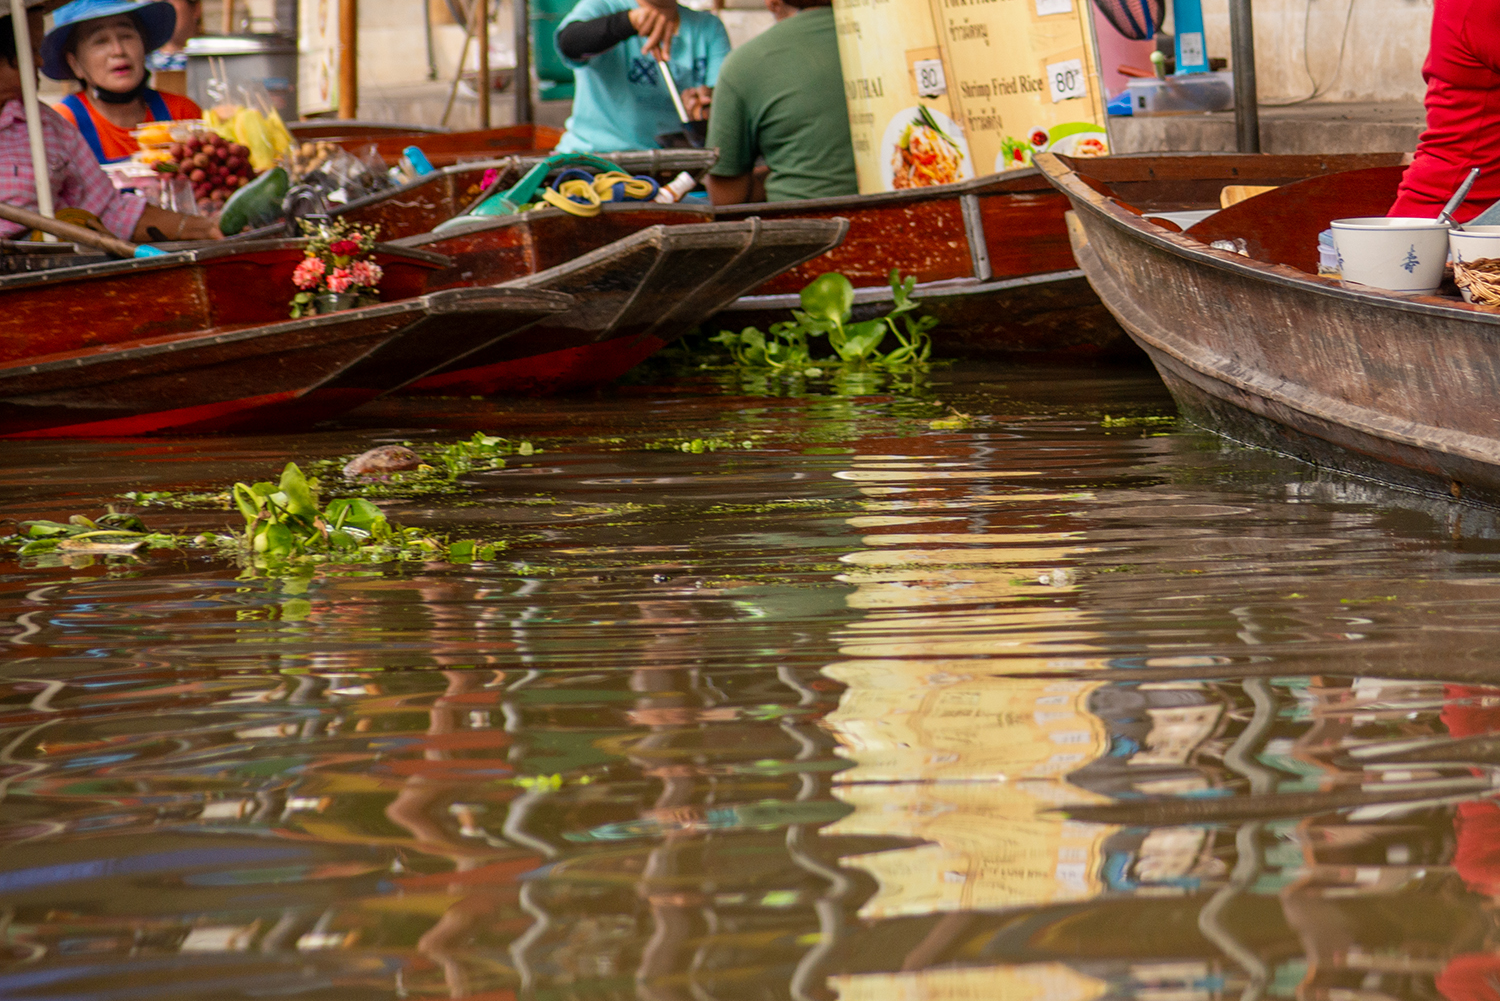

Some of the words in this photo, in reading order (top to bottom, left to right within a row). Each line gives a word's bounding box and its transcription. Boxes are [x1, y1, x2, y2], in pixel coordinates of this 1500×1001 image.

[921, 68, 938, 89] 80
[961, 80, 991, 101] Shrimp
[991, 77, 1018, 96] Fried
[1019, 74, 1043, 93] Rice
[1056, 70, 1075, 93] 80
